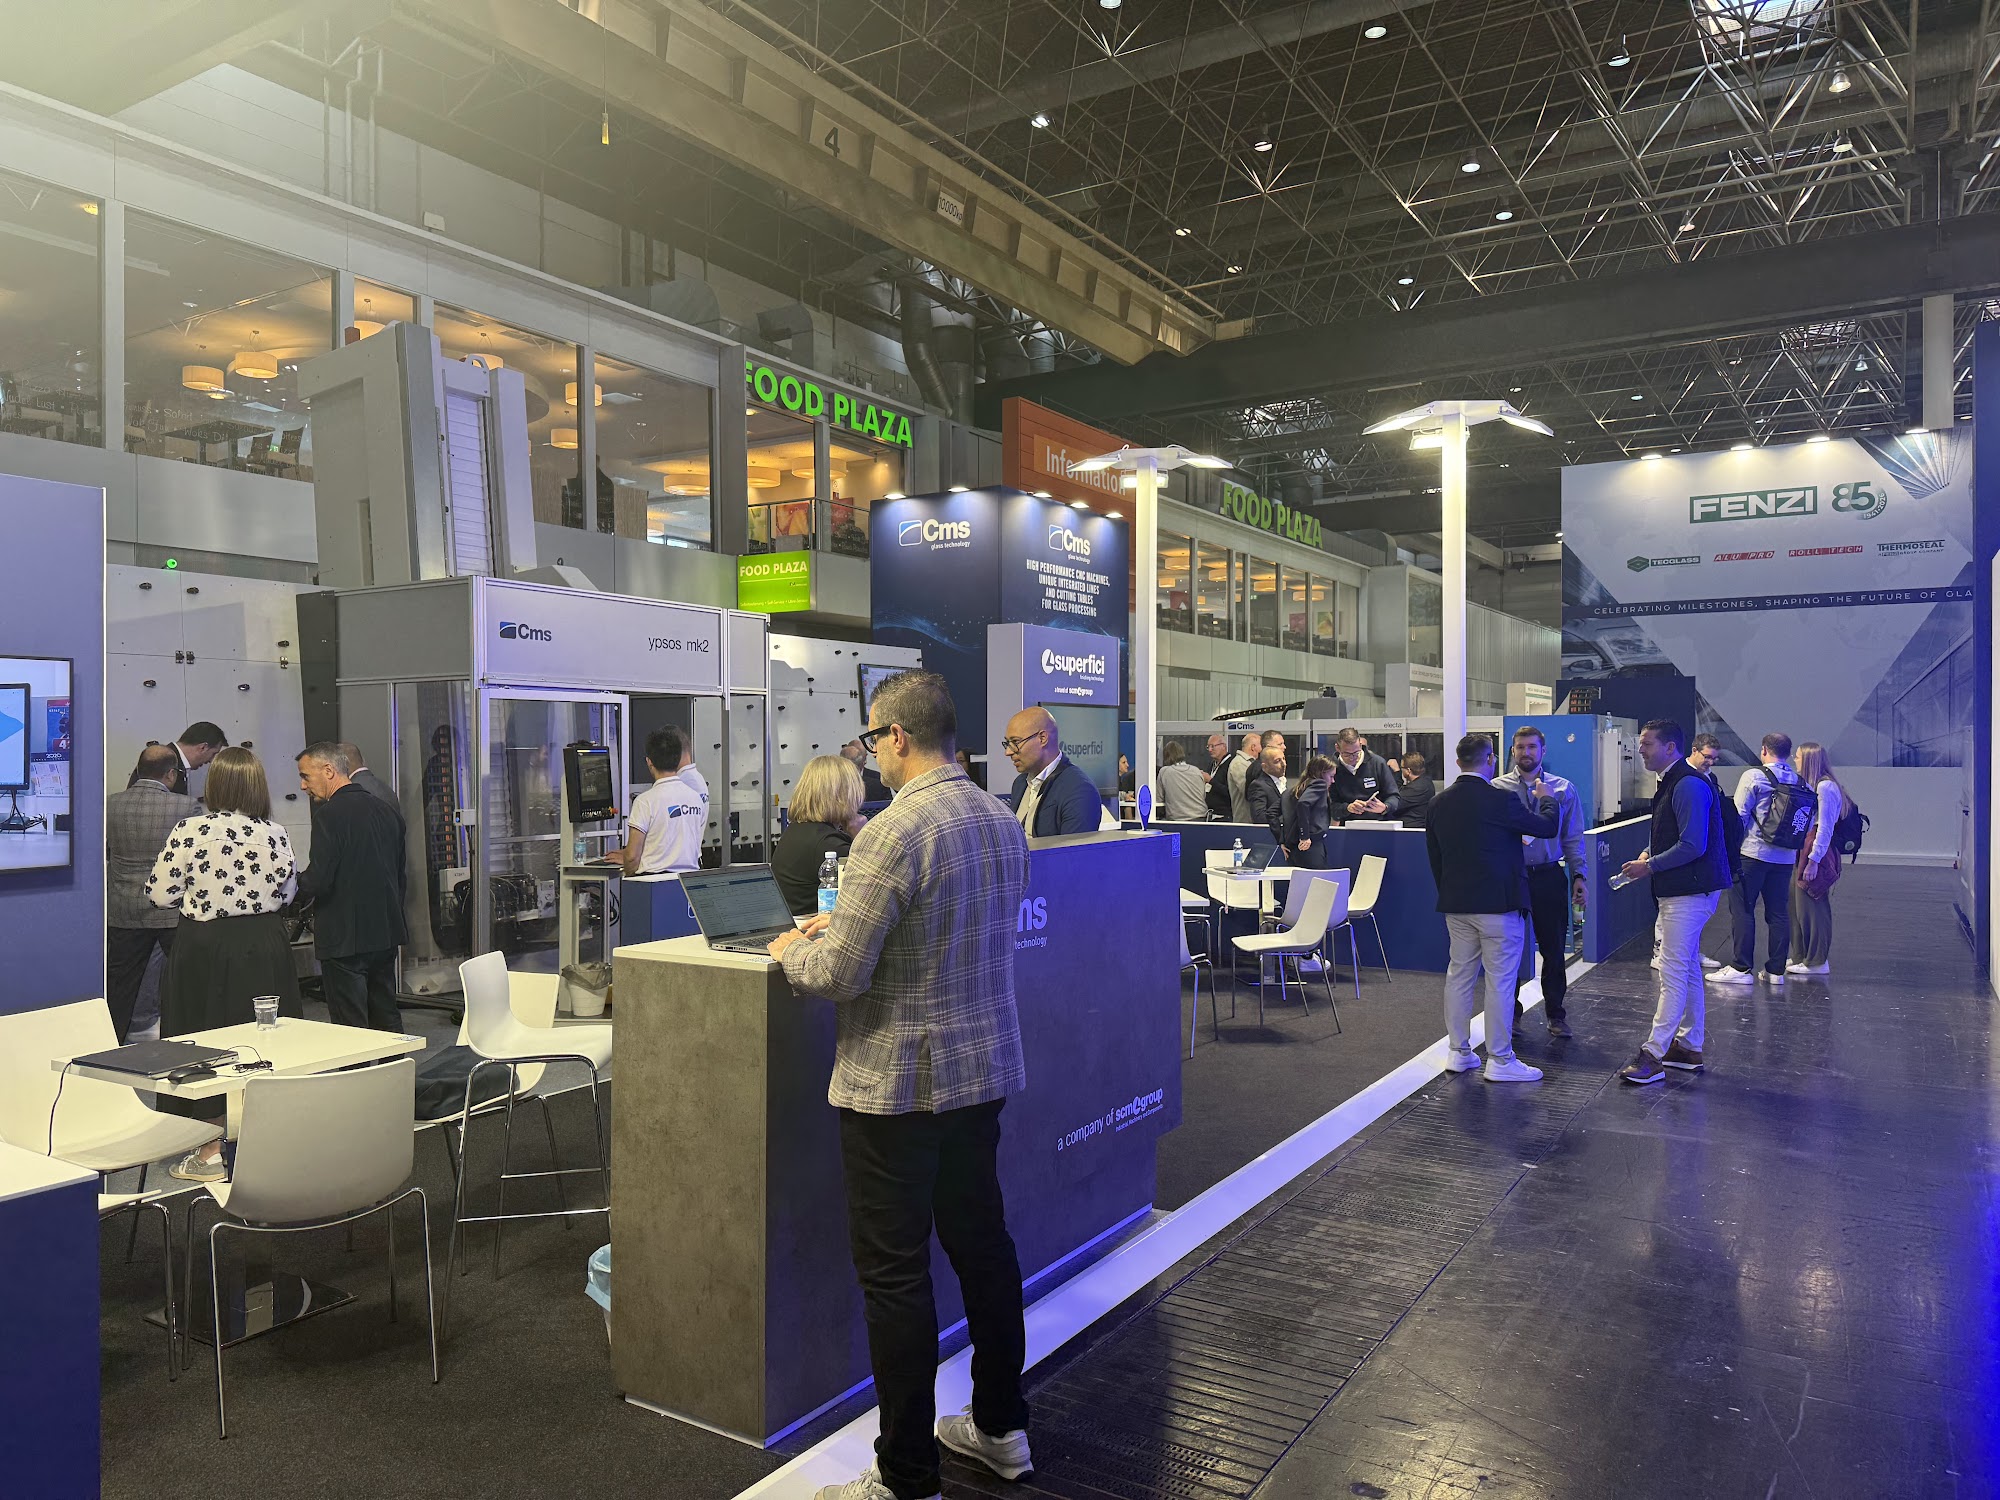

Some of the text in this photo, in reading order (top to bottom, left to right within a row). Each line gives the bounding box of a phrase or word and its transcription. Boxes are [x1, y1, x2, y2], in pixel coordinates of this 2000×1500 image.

[825, 127, 840, 157] 4
[834, 392, 913, 448] PLAZA
[1693, 489, 1814, 521] FENZI
[1832, 481, 1875, 512] 85
[1223, 482, 1323, 549] FOOD PLAZA
[923, 518, 971, 541] Cms
[931, 541, 970, 551] glass technology
[1064, 529, 1090, 555] Cms
[1789, 545, 1863, 557] ROLL TECH
[1877, 540, 1945, 551] THERMOSEAL
[1652, 556, 1700, 566] TECGLASS
[1715, 551, 1775, 561] ALU PRO
[740, 561, 807, 577] FOOD PLAZA
[1027, 559, 1039, 571] HIGH
[1040, 562, 1075, 578] PERFORMANCE
[1039, 573, 1099, 595] UNIQUE INTEGRATED LINES
[1046, 587, 1093, 605] AND CUTTING TABLES
[1594, 604, 1671, 615] CELEBRATING
[1678, 600, 1758, 611] MILESTONES,
[1765, 597, 1820, 607] SHAPING
[1860, 592, 1911, 602] FUTURE
[1920, 591, 1937, 599] OF
[1946, 589, 1973, 598] GLA
[1042, 598, 1097, 617] FOR GLASS PROCESSING
[517, 623, 552, 642] Cms
[648, 636, 709, 653] ypsos mk2
[1055, 653, 1105, 676] superfici
[1237, 722, 1255, 730] Cms
[1068, 740, 1103, 757] superfici
[1057, 1138, 1063, 1151] a
[1065, 1117, 1104, 1147] company
[1106, 1108, 1114, 1126] of
